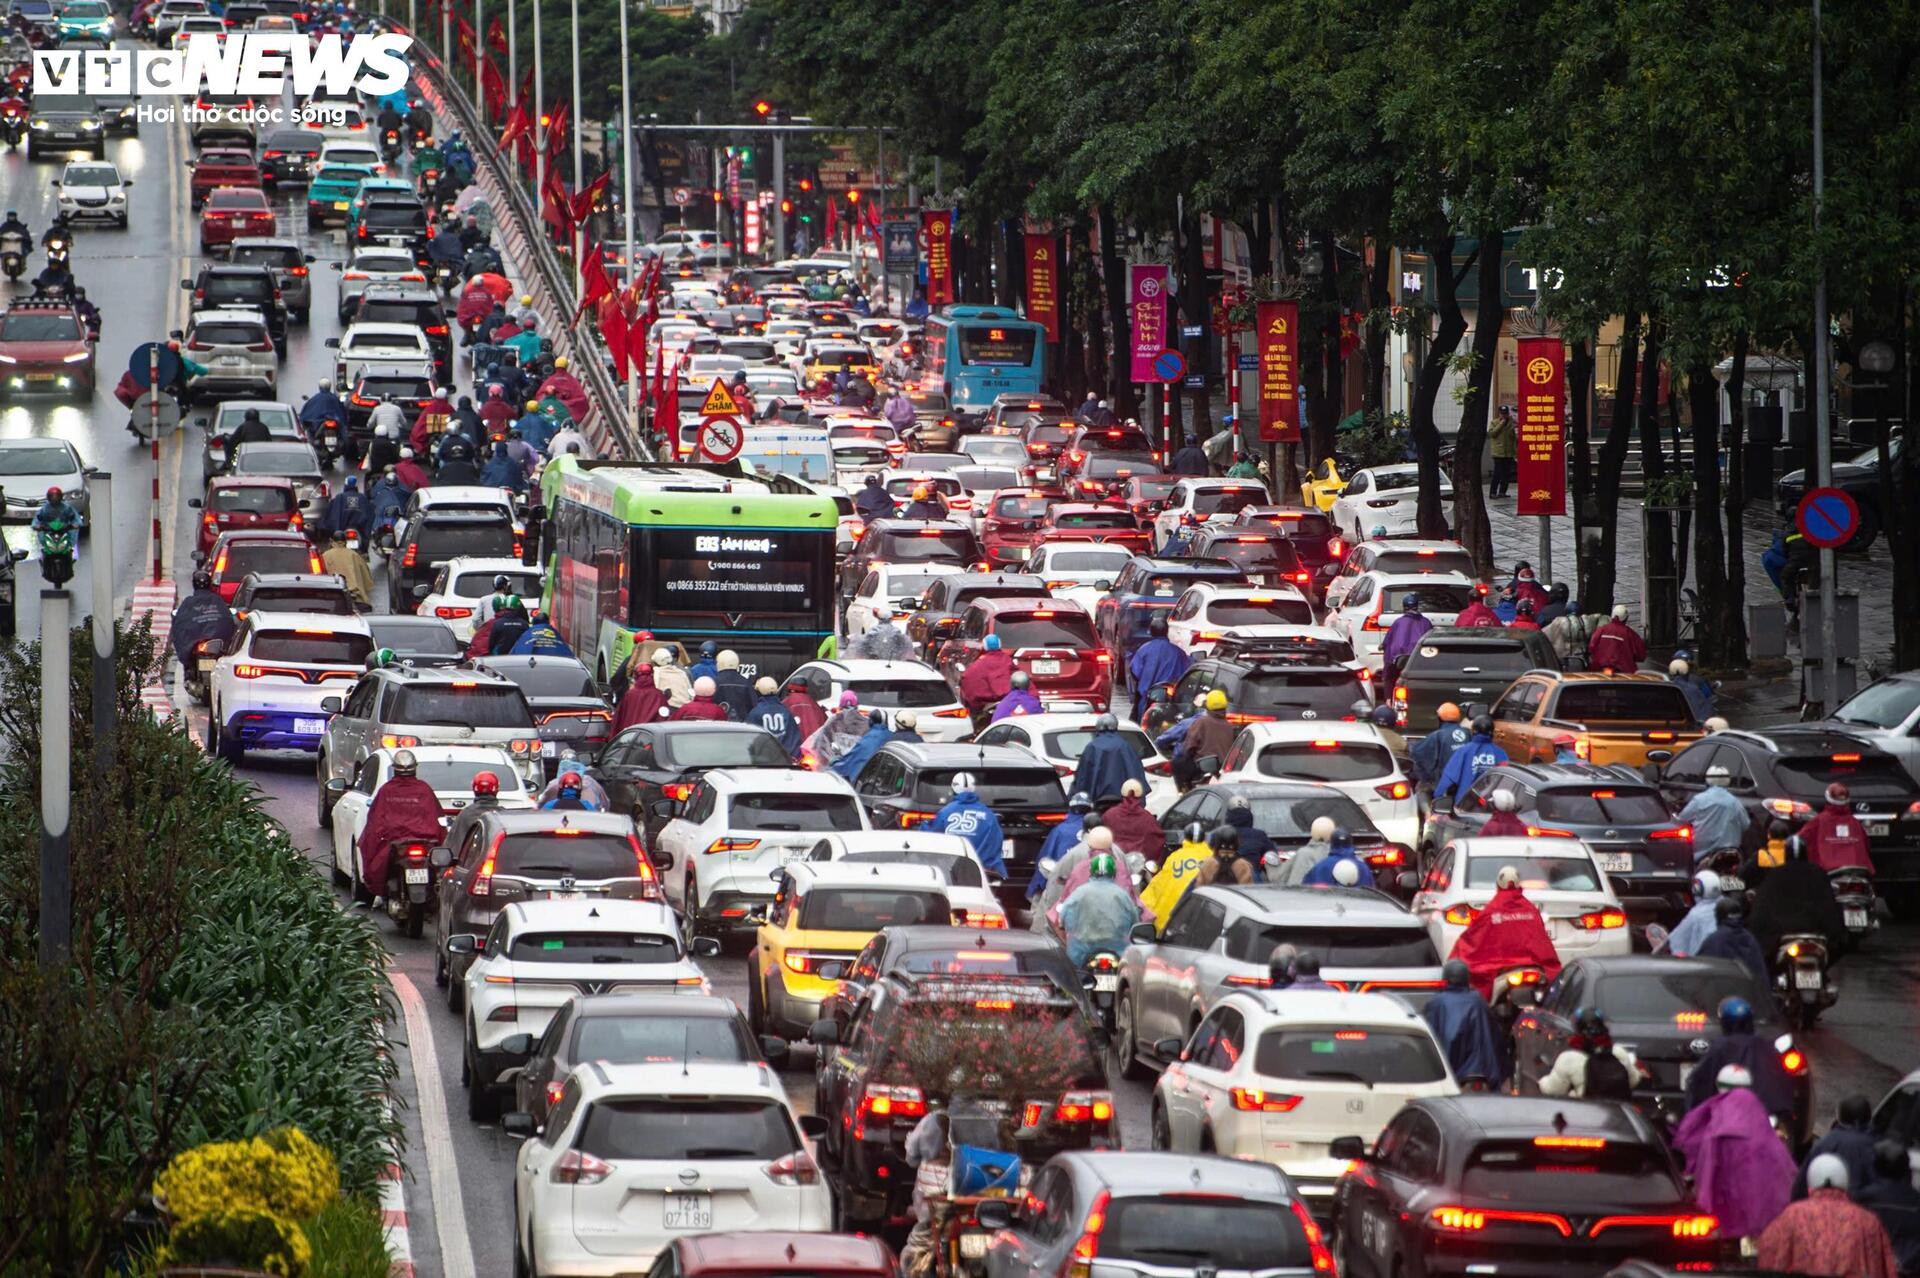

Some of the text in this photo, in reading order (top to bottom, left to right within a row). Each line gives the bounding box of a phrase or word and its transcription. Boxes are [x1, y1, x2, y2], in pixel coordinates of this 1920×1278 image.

[707, 581, 720, 591] 222
[1472, 753, 1495, 766] ACB
[677, 1195, 701, 1210] 12A
